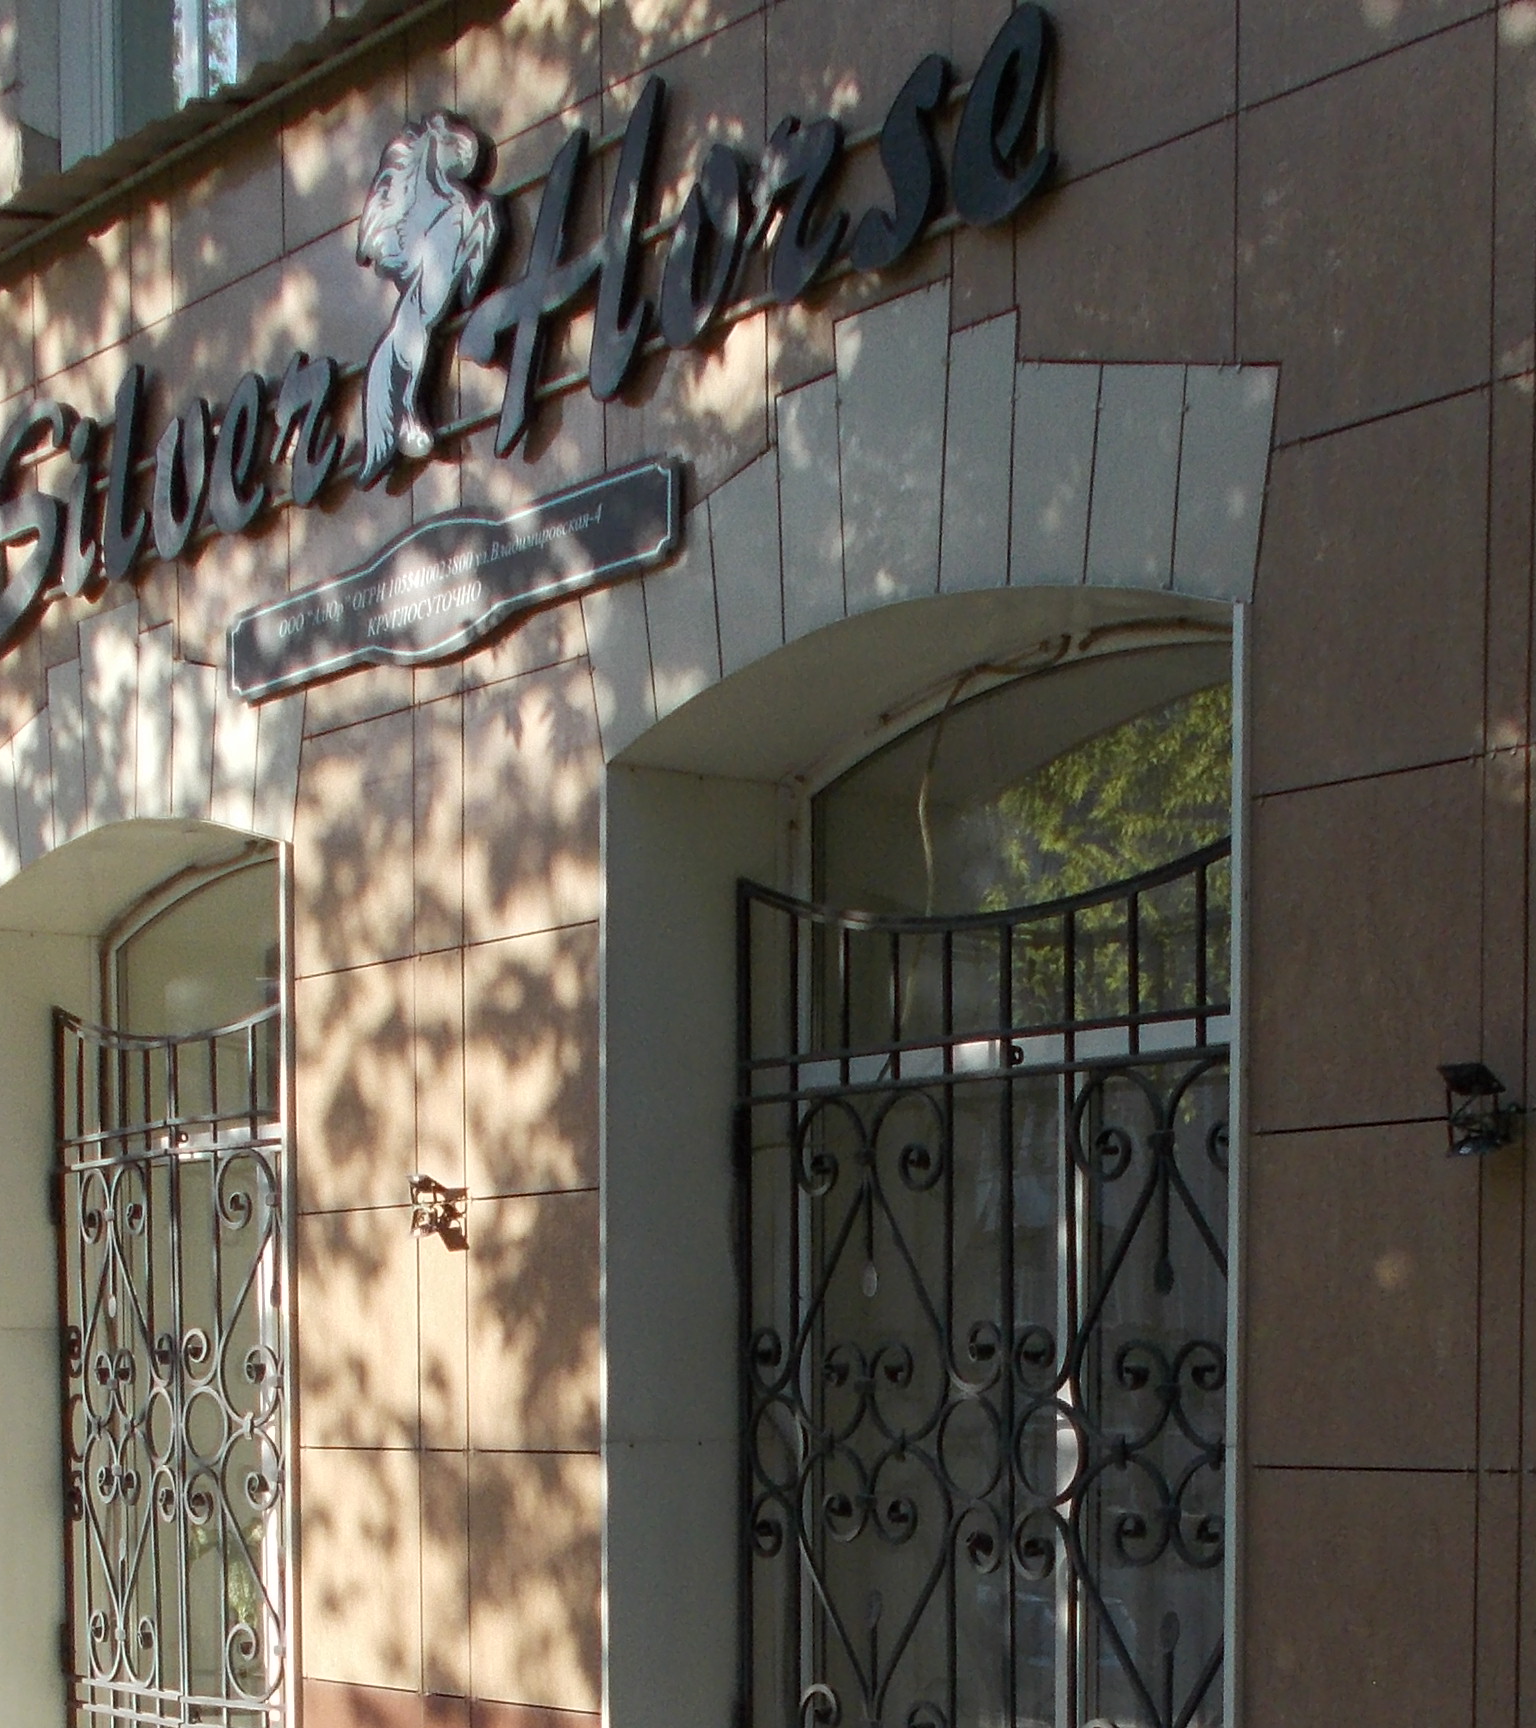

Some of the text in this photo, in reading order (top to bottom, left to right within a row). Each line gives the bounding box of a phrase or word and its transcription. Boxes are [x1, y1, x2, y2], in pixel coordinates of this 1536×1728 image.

[459, 2, 1057, 460] Horse
[279, 613, 304, 639] ООО
[352, 582, 387, 610] ОГРН
[367, 580, 482, 638] КРУГЛОСУТОЧНО
